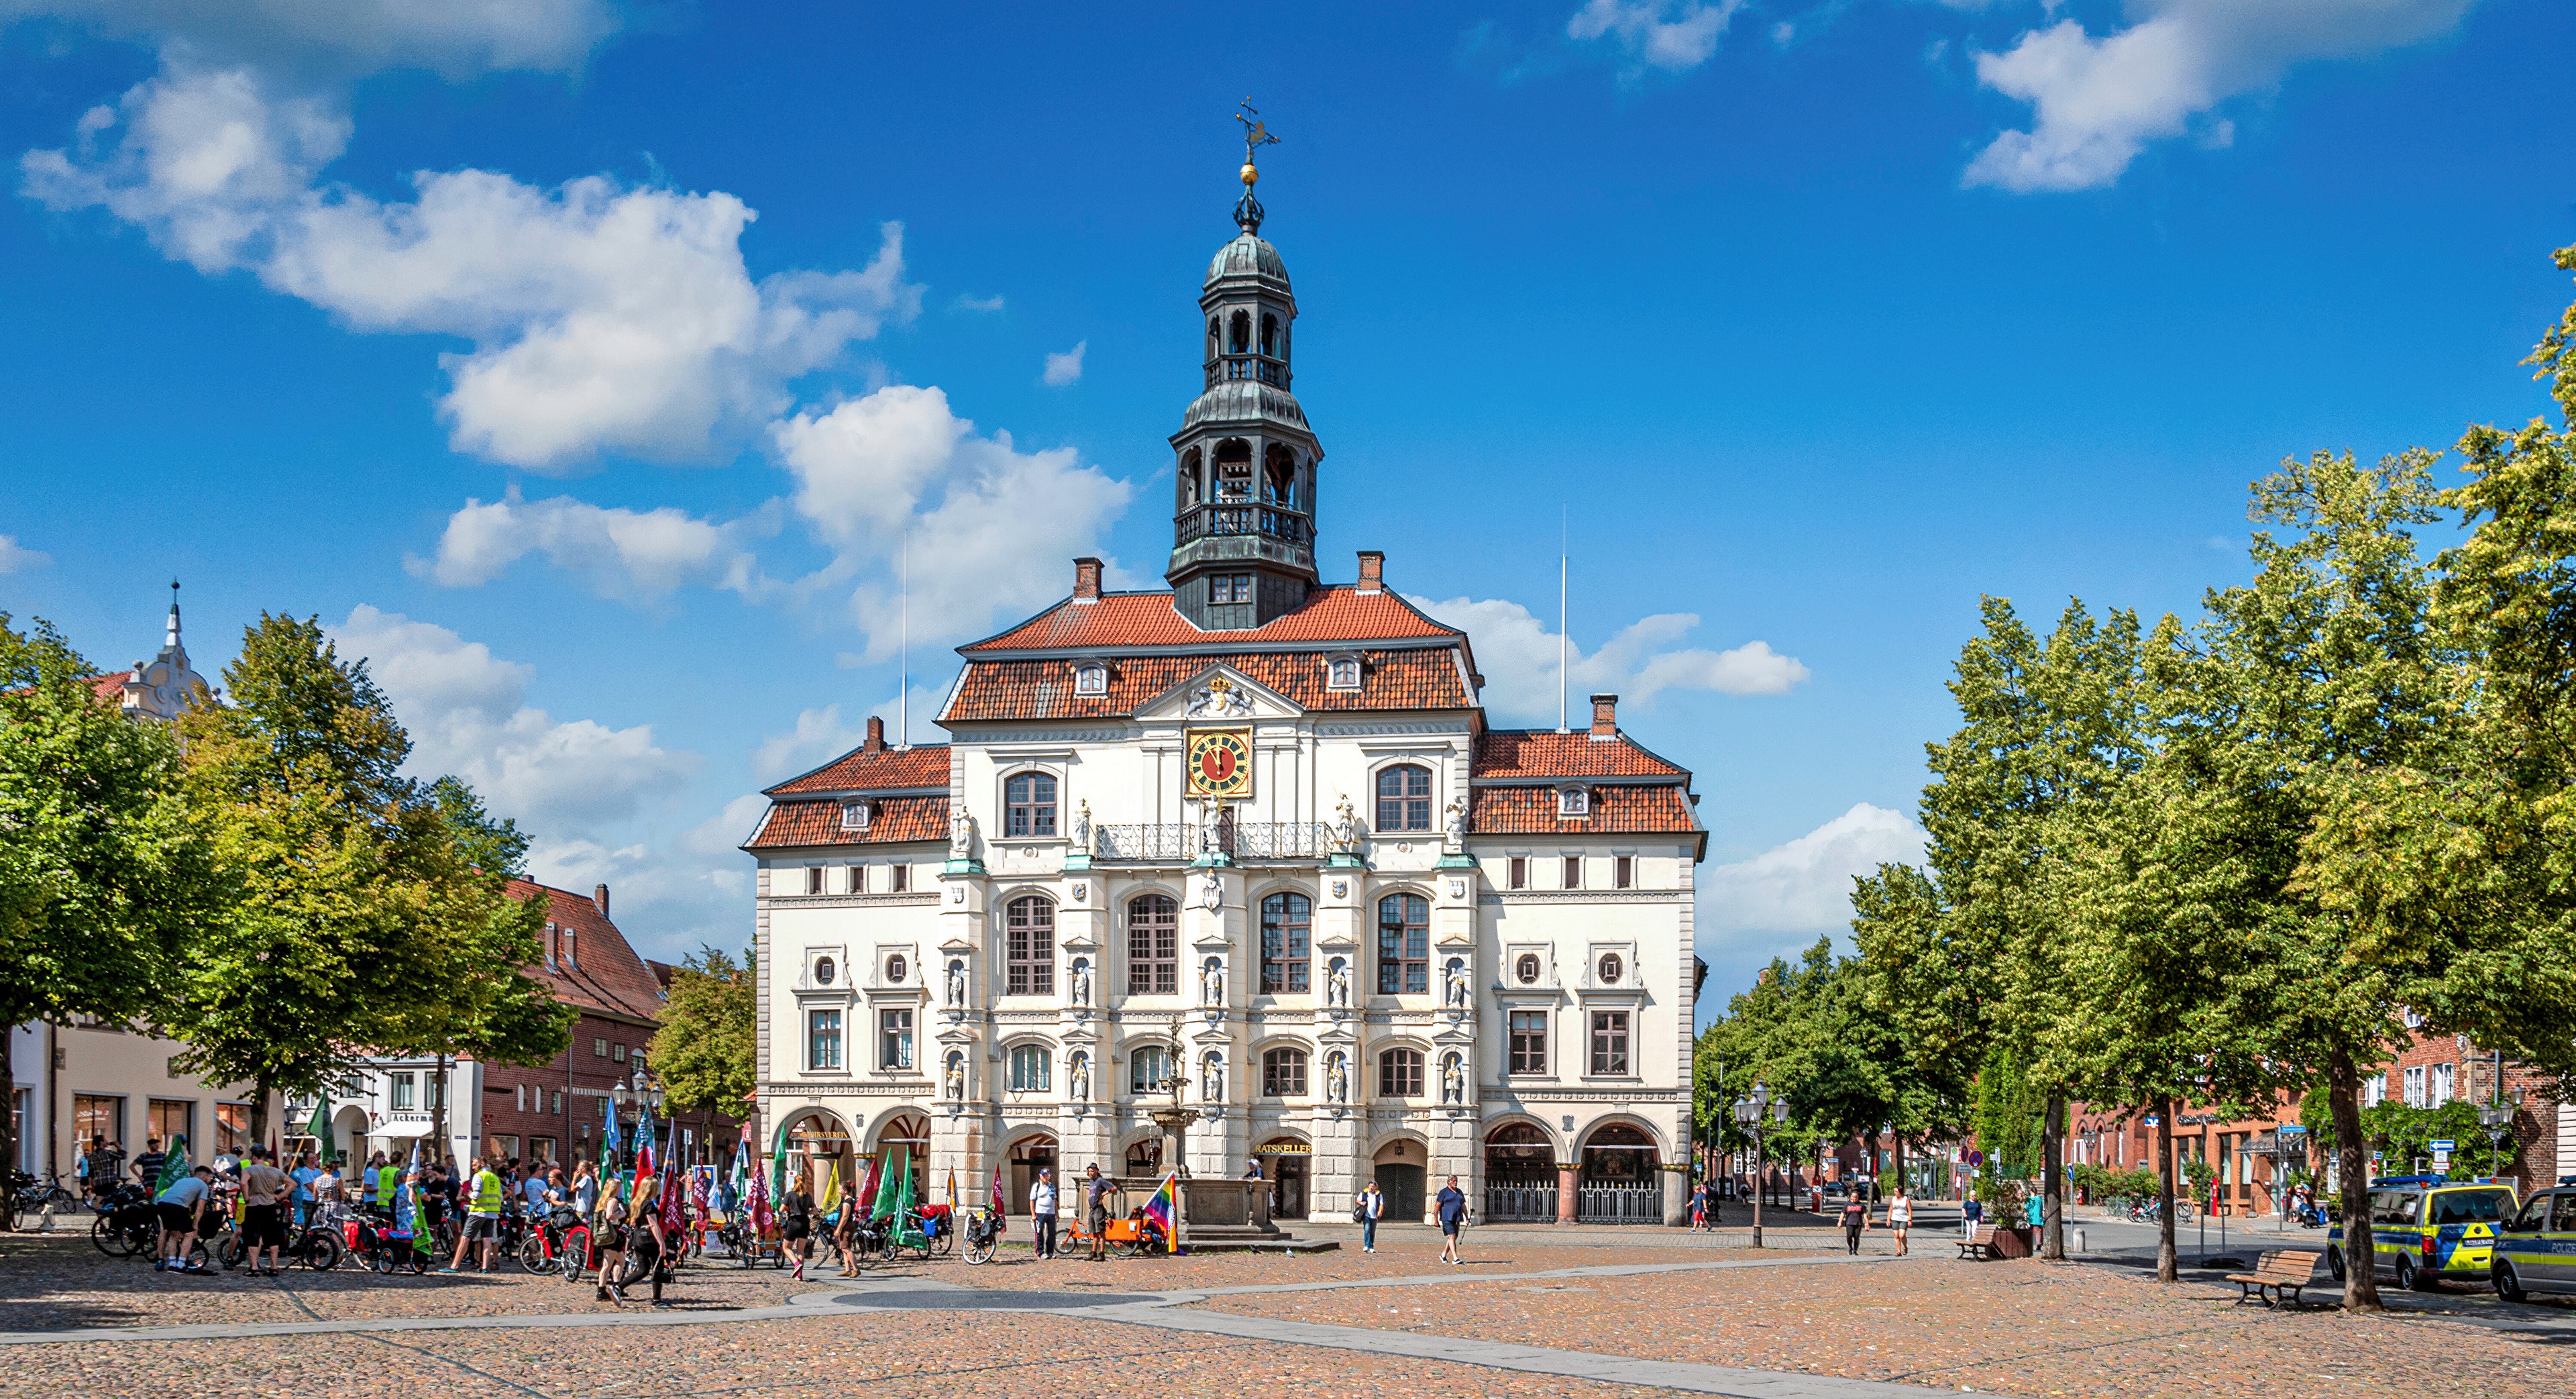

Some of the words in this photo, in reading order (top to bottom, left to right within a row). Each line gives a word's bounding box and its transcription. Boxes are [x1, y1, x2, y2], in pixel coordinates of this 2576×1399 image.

[393, 1114, 433, 1122] Ackerma
[1255, 1144, 1311, 1153] RATSKELLER
[2552, 1243, 2576, 1253] POLIZE
